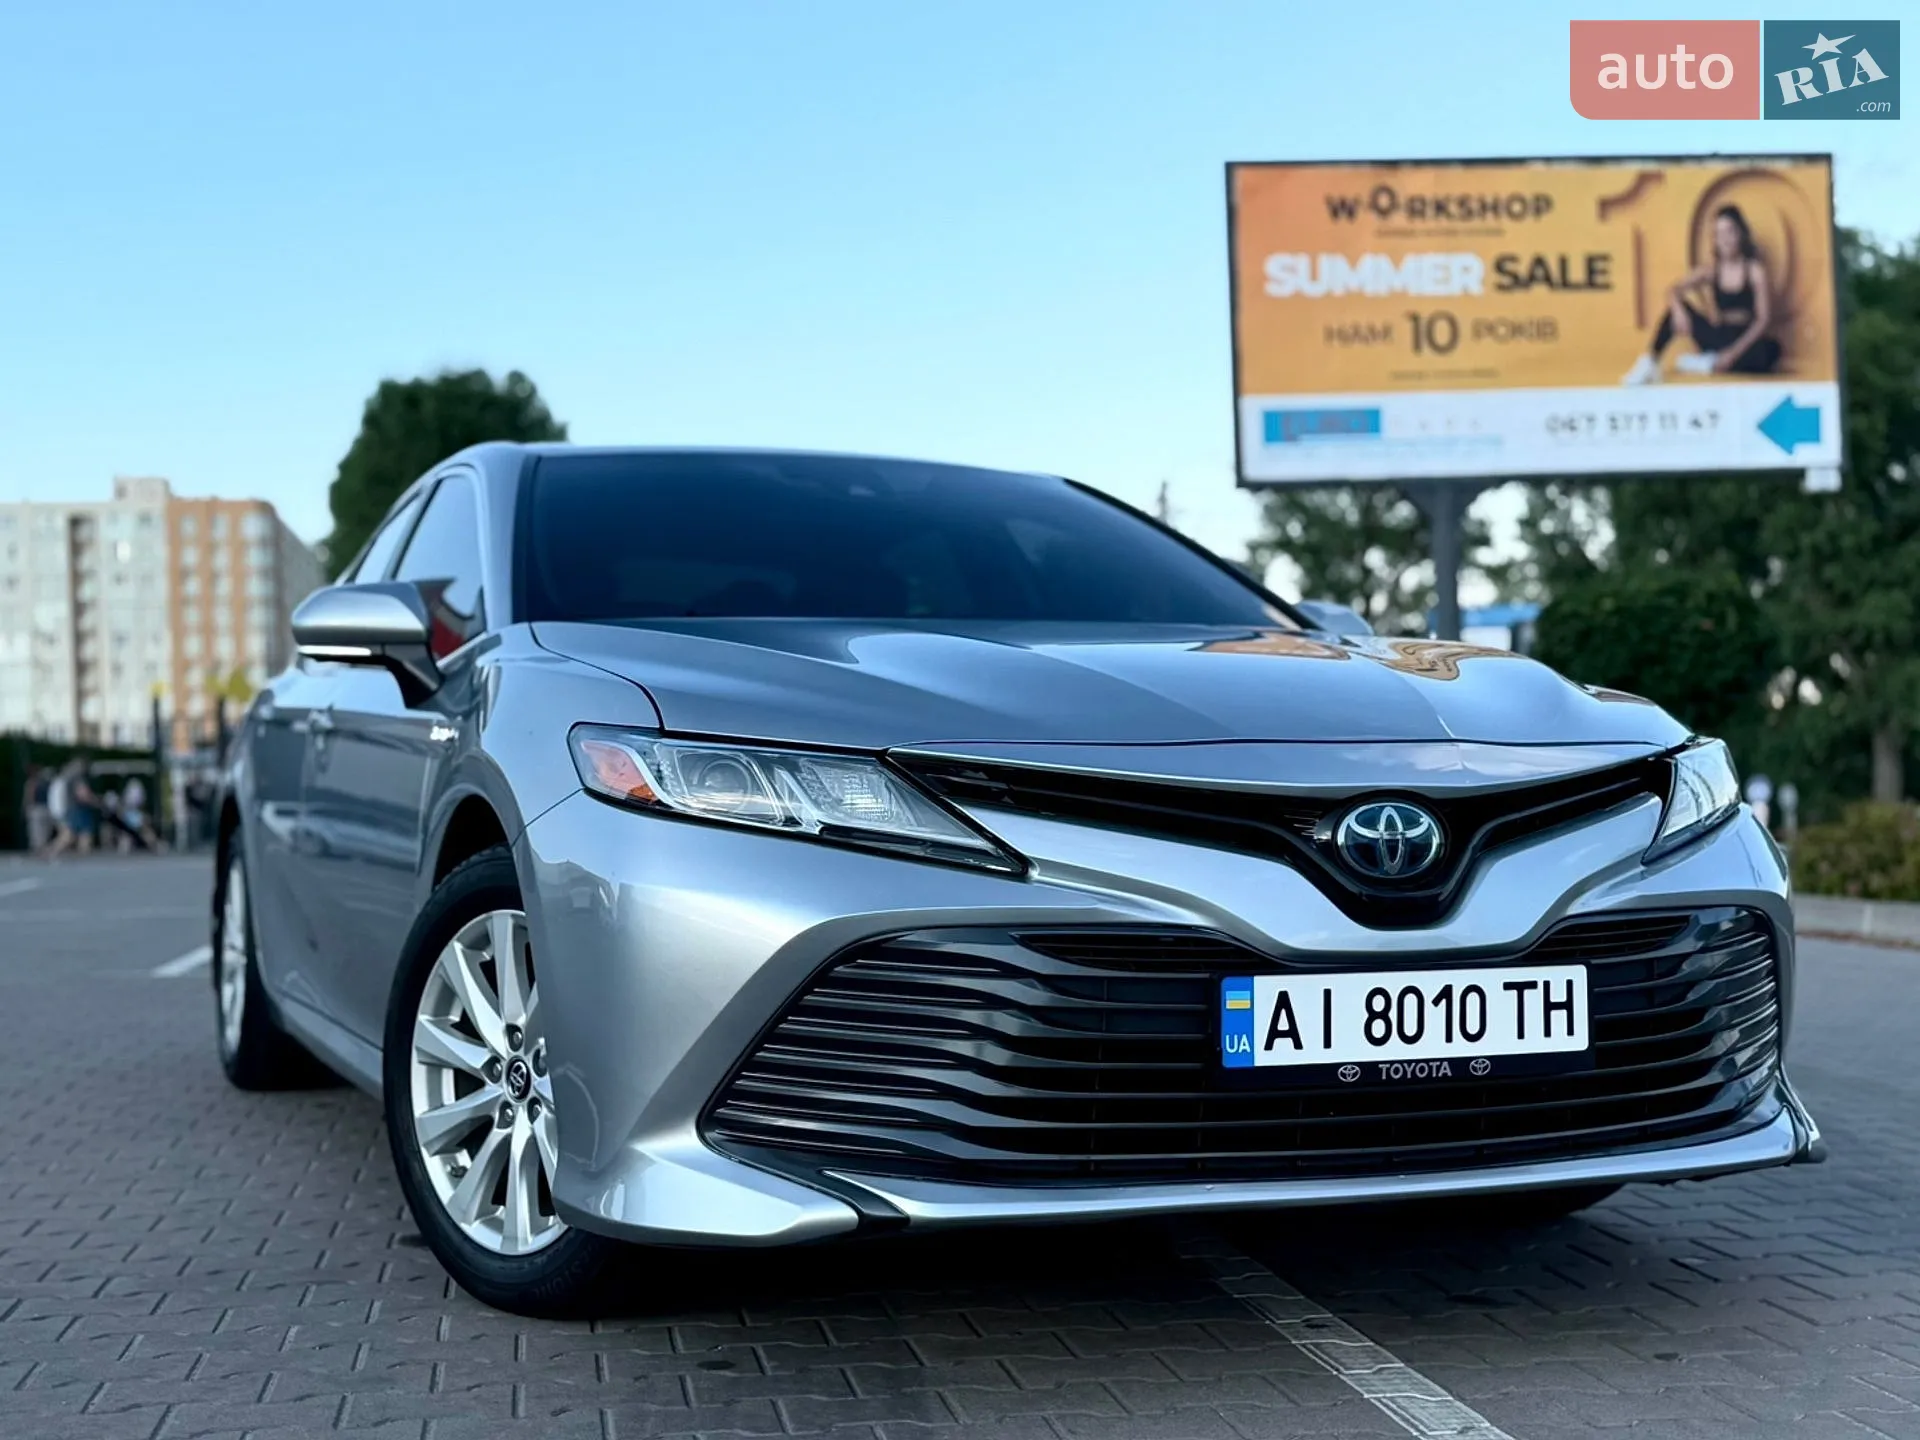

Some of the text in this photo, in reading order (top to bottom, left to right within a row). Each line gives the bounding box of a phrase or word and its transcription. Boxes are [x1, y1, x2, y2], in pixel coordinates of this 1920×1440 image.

[1326, 184, 1554, 223] WORKSHOP
[1263, 252, 1613, 299] SUMMER SALE
[1404, 310, 1460, 356] 10
[1263, 978, 1575, 1051] AI 8010 TH
[1225, 1034, 1251, 1054] UA
[1378, 1060, 1452, 1080] TOYOTA
